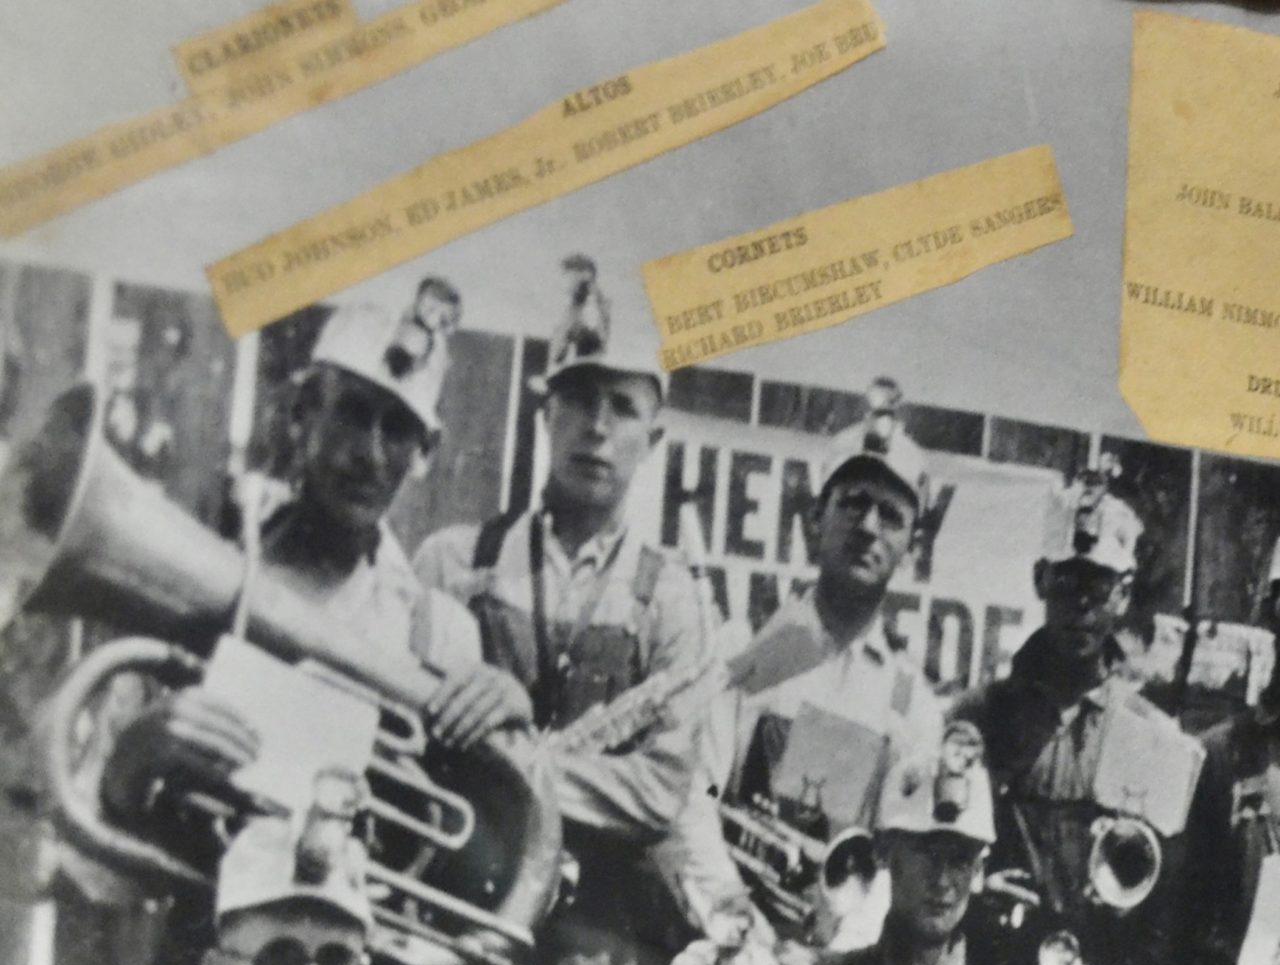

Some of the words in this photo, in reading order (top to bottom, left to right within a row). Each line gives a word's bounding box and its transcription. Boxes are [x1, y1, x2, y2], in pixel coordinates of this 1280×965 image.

[562, 74, 633, 118] ALTOS
[405, 198, 440, 227] ED
[572, 112, 663, 163] ROBERT
[790, 41, 831, 74] JOE
[1176, 183, 1231, 210] JOHN
[666, 305, 725, 336] BERT
[893, 224, 963, 263] CLYDE
[707, 226, 809, 274] CORNETS
[660, 319, 764, 371] RICHARD
[774, 279, 884, 333] BRIERLEY
[1125, 281, 1214, 319] WILLIAM
[661, 441, 956, 583] HENY
